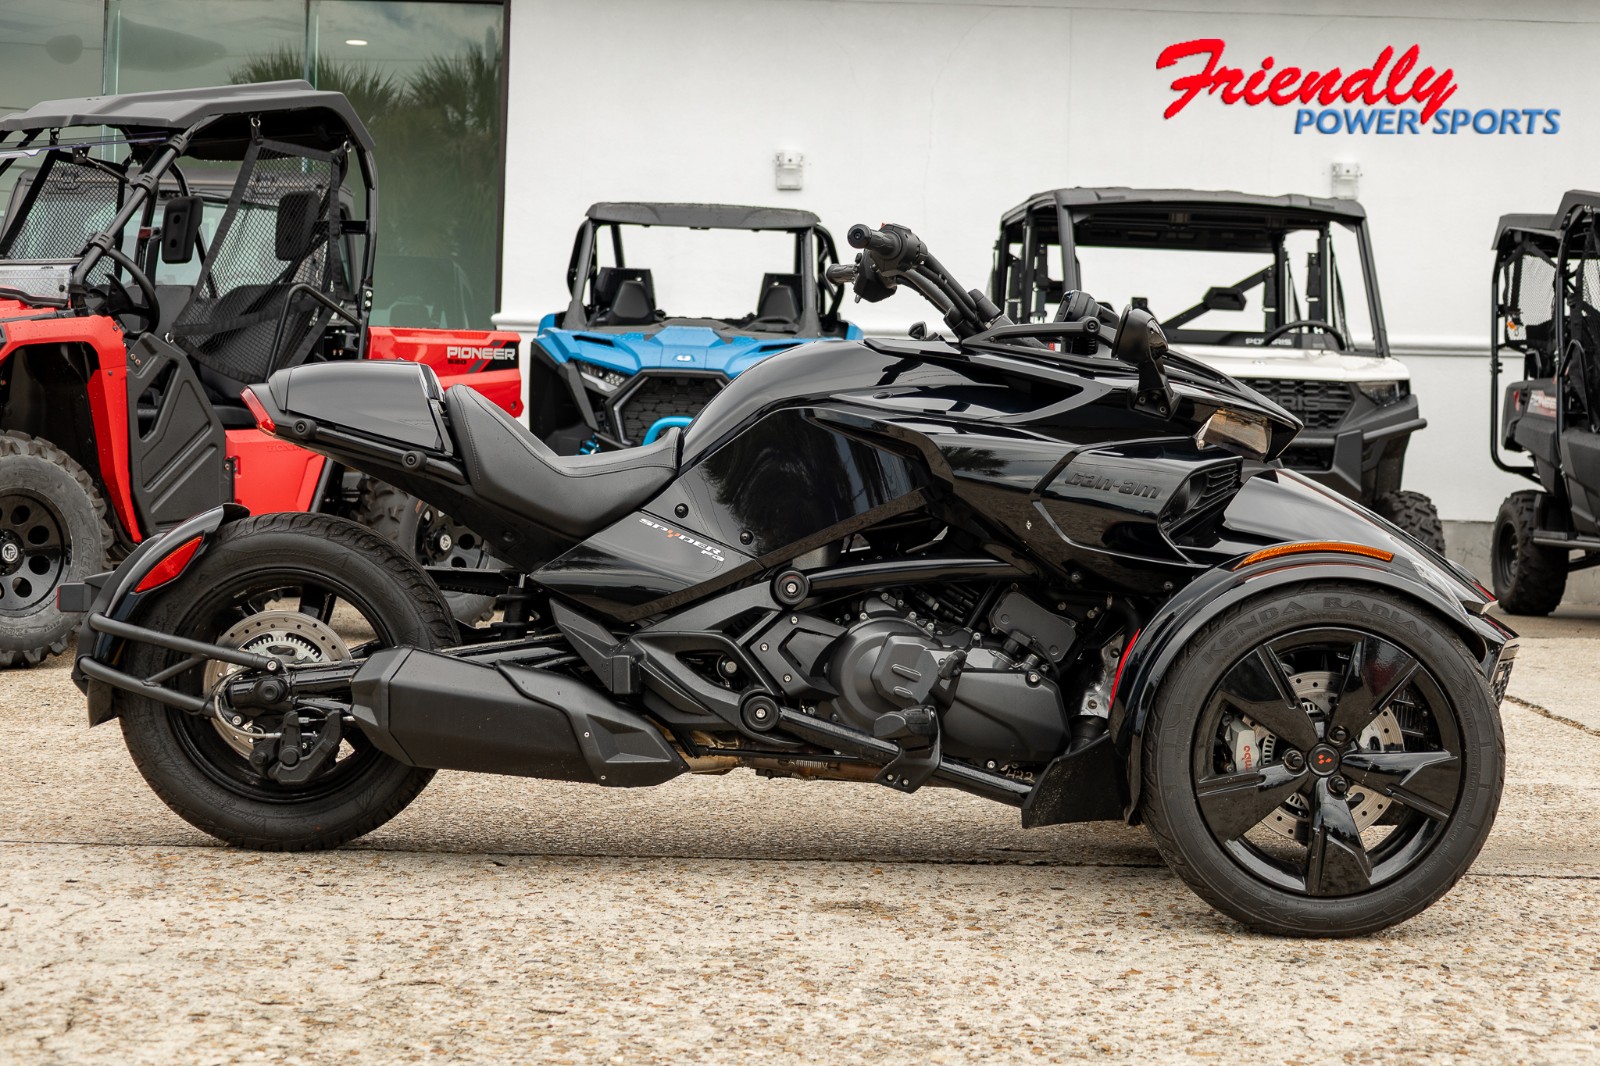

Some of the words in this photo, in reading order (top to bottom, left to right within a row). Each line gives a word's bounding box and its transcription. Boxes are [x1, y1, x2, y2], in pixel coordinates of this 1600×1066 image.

[446, 345, 516, 361] PIONEER
[1064, 472, 1162, 500] can-am
[638, 517, 722, 555] SPYDER
[1201, 600, 1307, 665] KENDA
[1322, 596, 1438, 648] RADIAL
